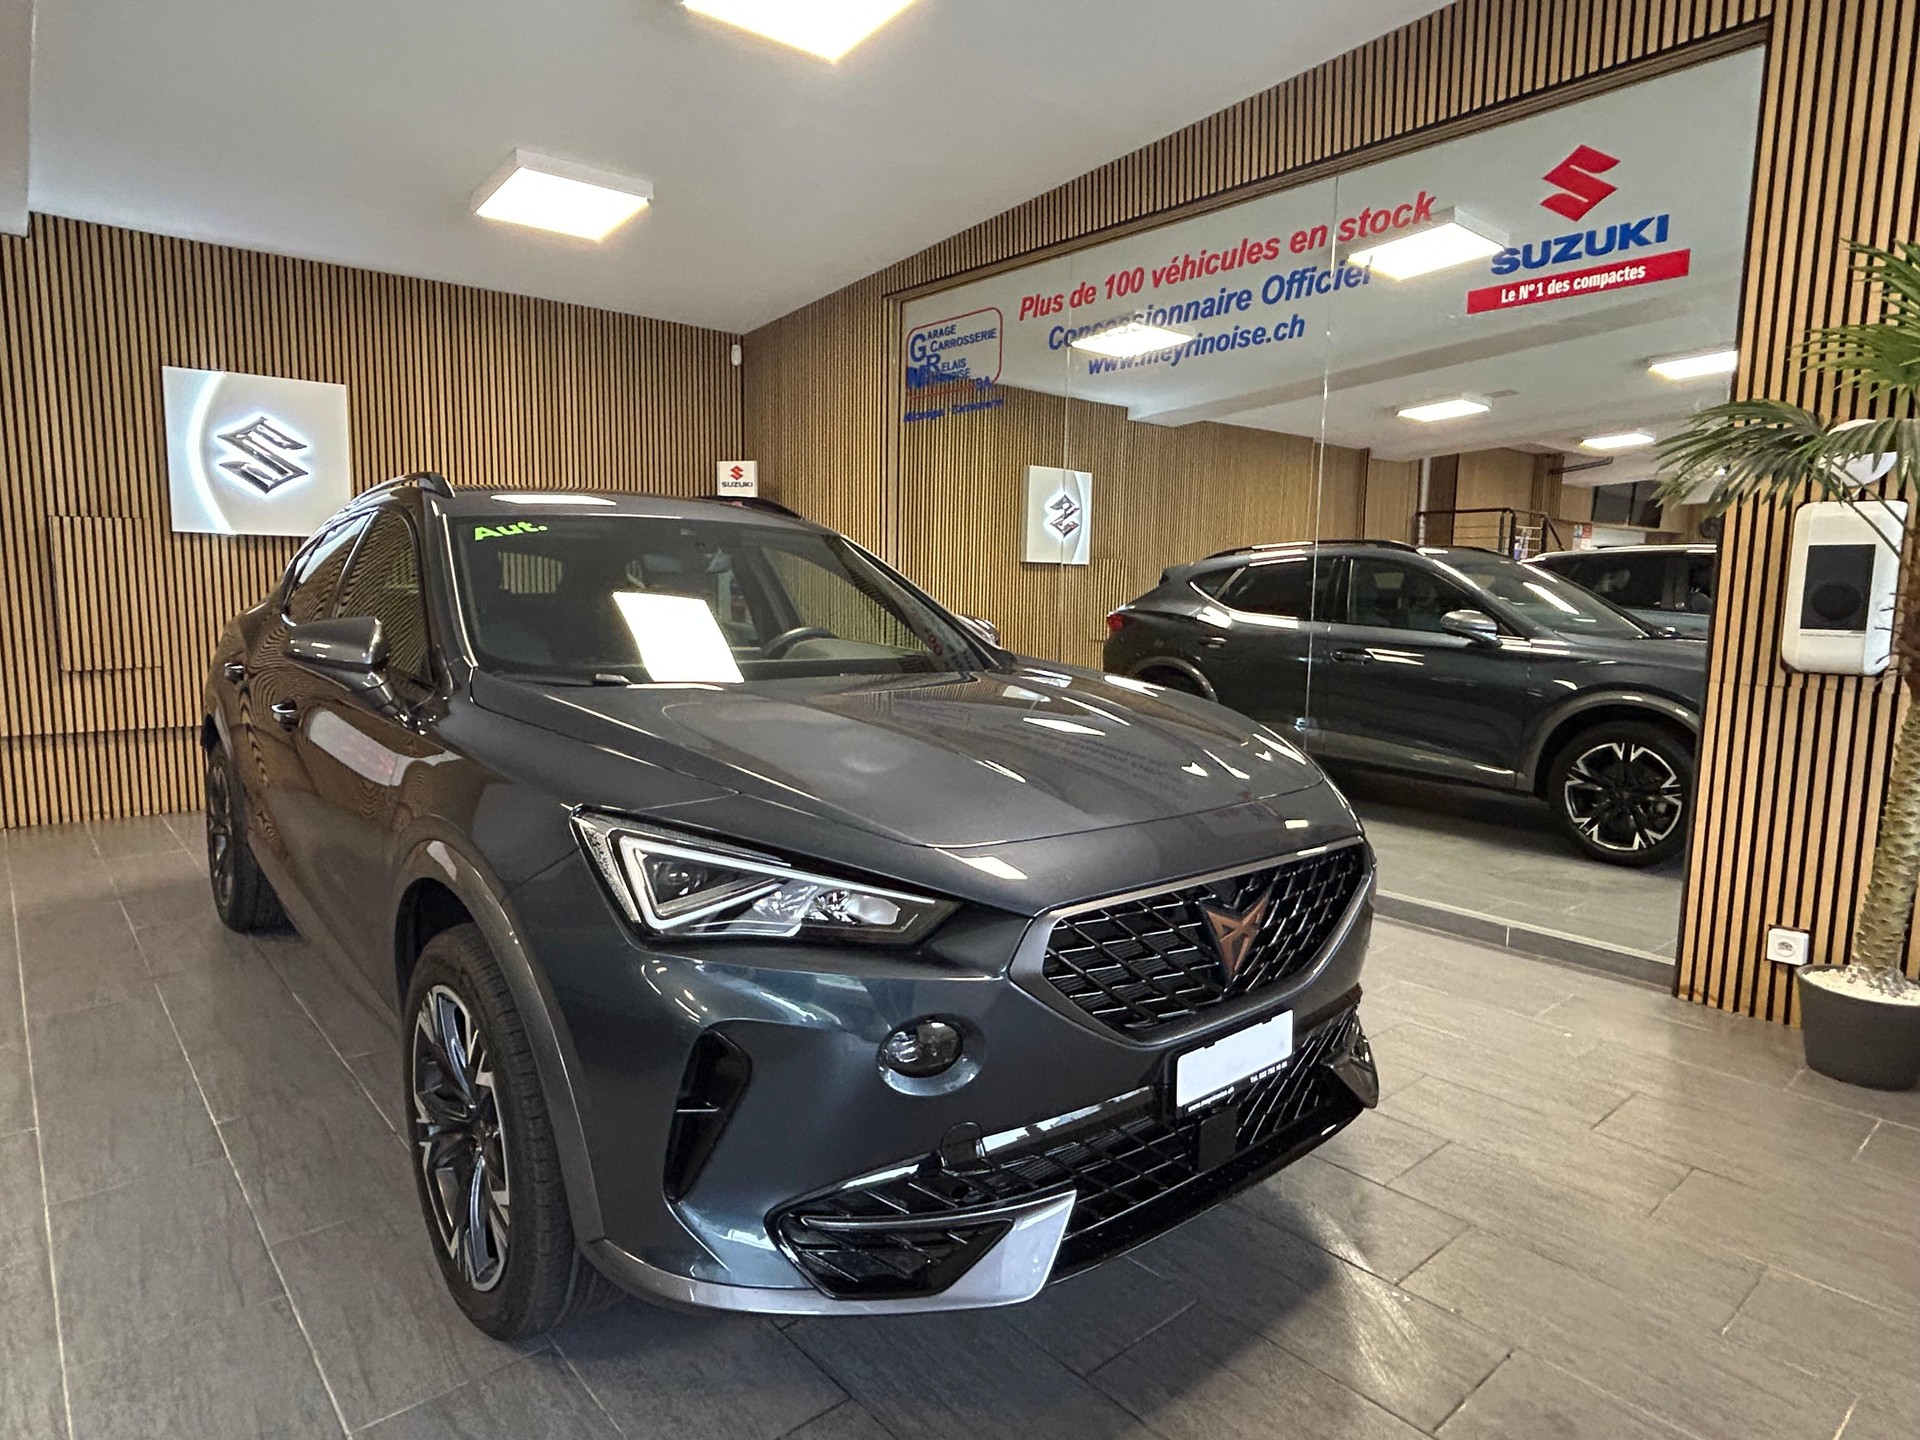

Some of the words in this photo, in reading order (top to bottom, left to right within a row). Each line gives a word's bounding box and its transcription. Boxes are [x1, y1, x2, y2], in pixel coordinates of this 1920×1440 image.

[1019, 294, 1064, 321] Plus
[1069, 281, 1097, 308] de
[1105, 267, 1145, 299] 100
[1152, 238, 1281, 288] véhicules
[1290, 224, 1328, 254] en
[1338, 191, 1437, 242] stock
[1491, 214, 1670, 275] SUZUKI
[1501, 288, 1516, 304] Le
[1547, 277, 1570, 296] des
[1573, 265, 1646, 290] compactes
[930, 328, 998, 352] CARROSSERIE
[474, 521, 548, 541] Aut.
